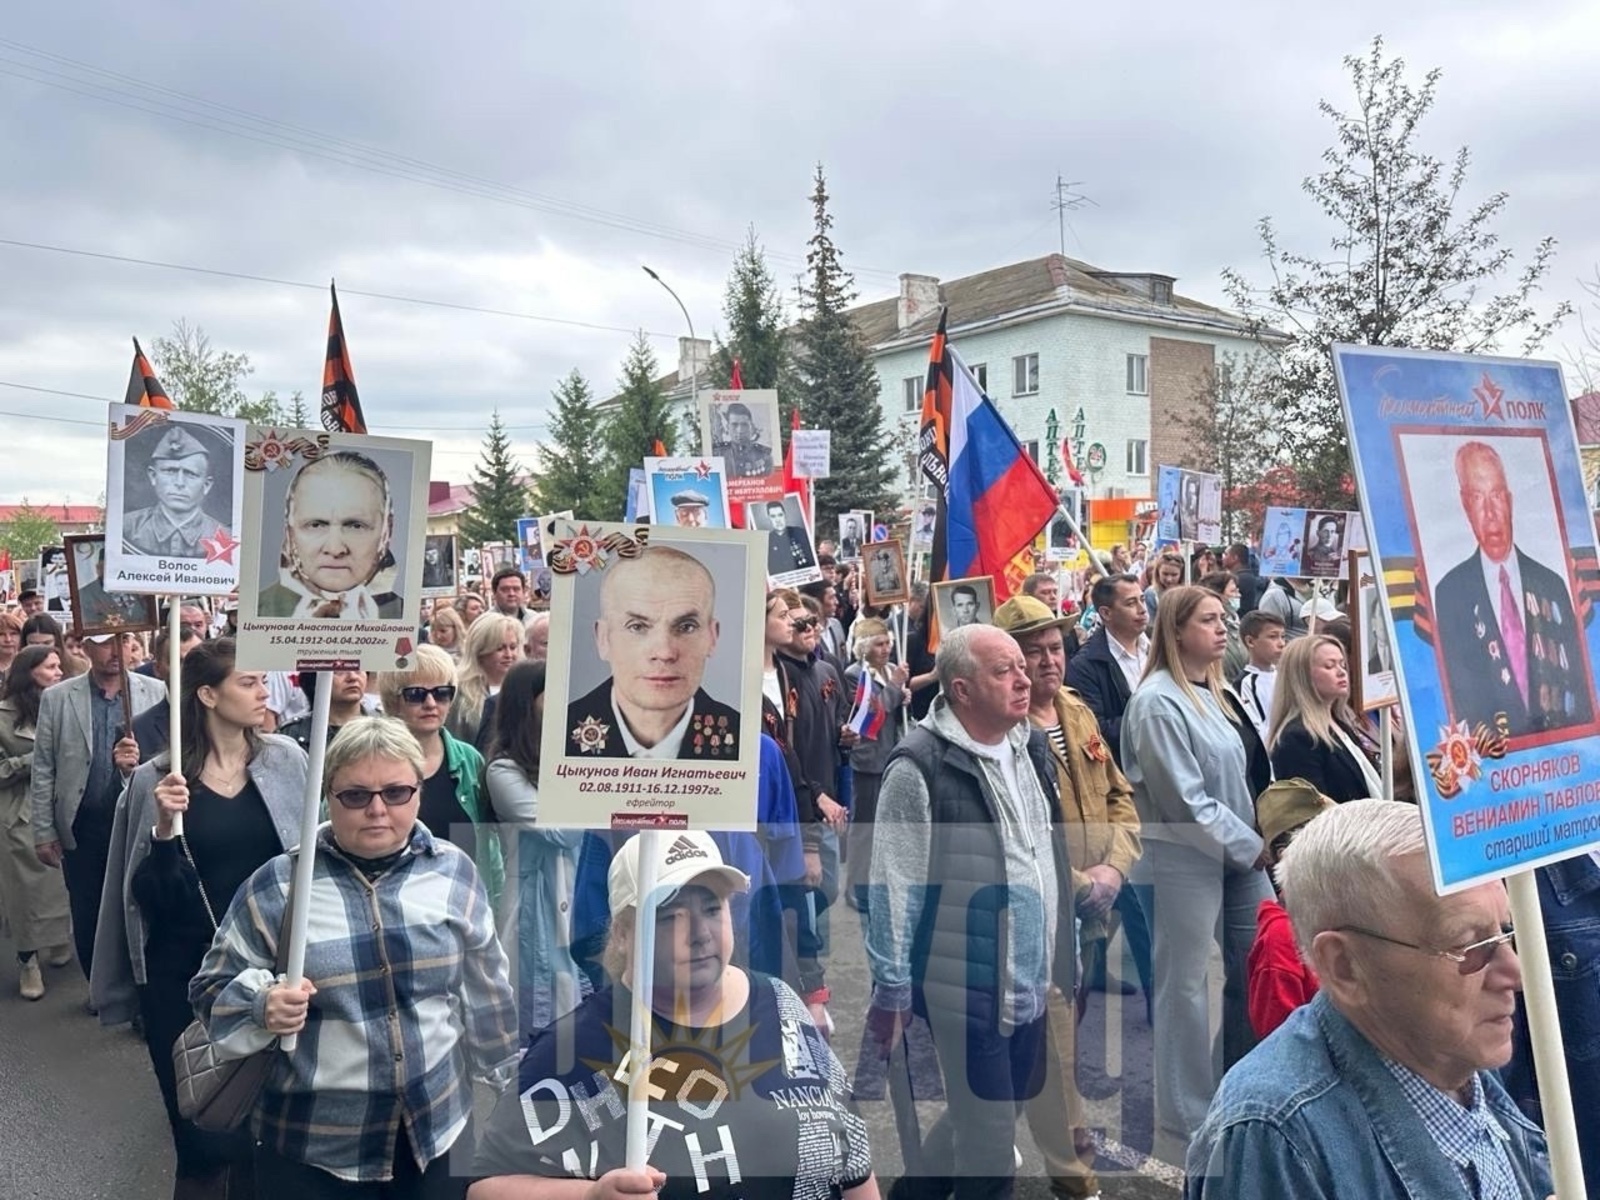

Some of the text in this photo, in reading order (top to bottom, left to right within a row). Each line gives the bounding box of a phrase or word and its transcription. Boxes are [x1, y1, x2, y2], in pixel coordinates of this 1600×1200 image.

[158, 560, 198, 571] Волос
[117, 570, 235, 585] Алексей Иванович
[243, 623, 414, 633] Цыкунова Анастасия Михайловна
[270, 636, 389, 645] 15.04.1912-04.04.2002гг.
[556, 764, 746, 780] Цыкунов Иван Игнатьевич
[1490, 754, 1581, 792] СКОРНЯКОВ
[579, 782, 723, 795] 02.08.1911-16.12.1997гг.
[626, 798, 675, 808] ефрейтор
[1453, 796, 1541, 838] ВЕНИАМИН
[1485, 823, 1550, 860] старший
[665, 849, 708, 865] adidas
